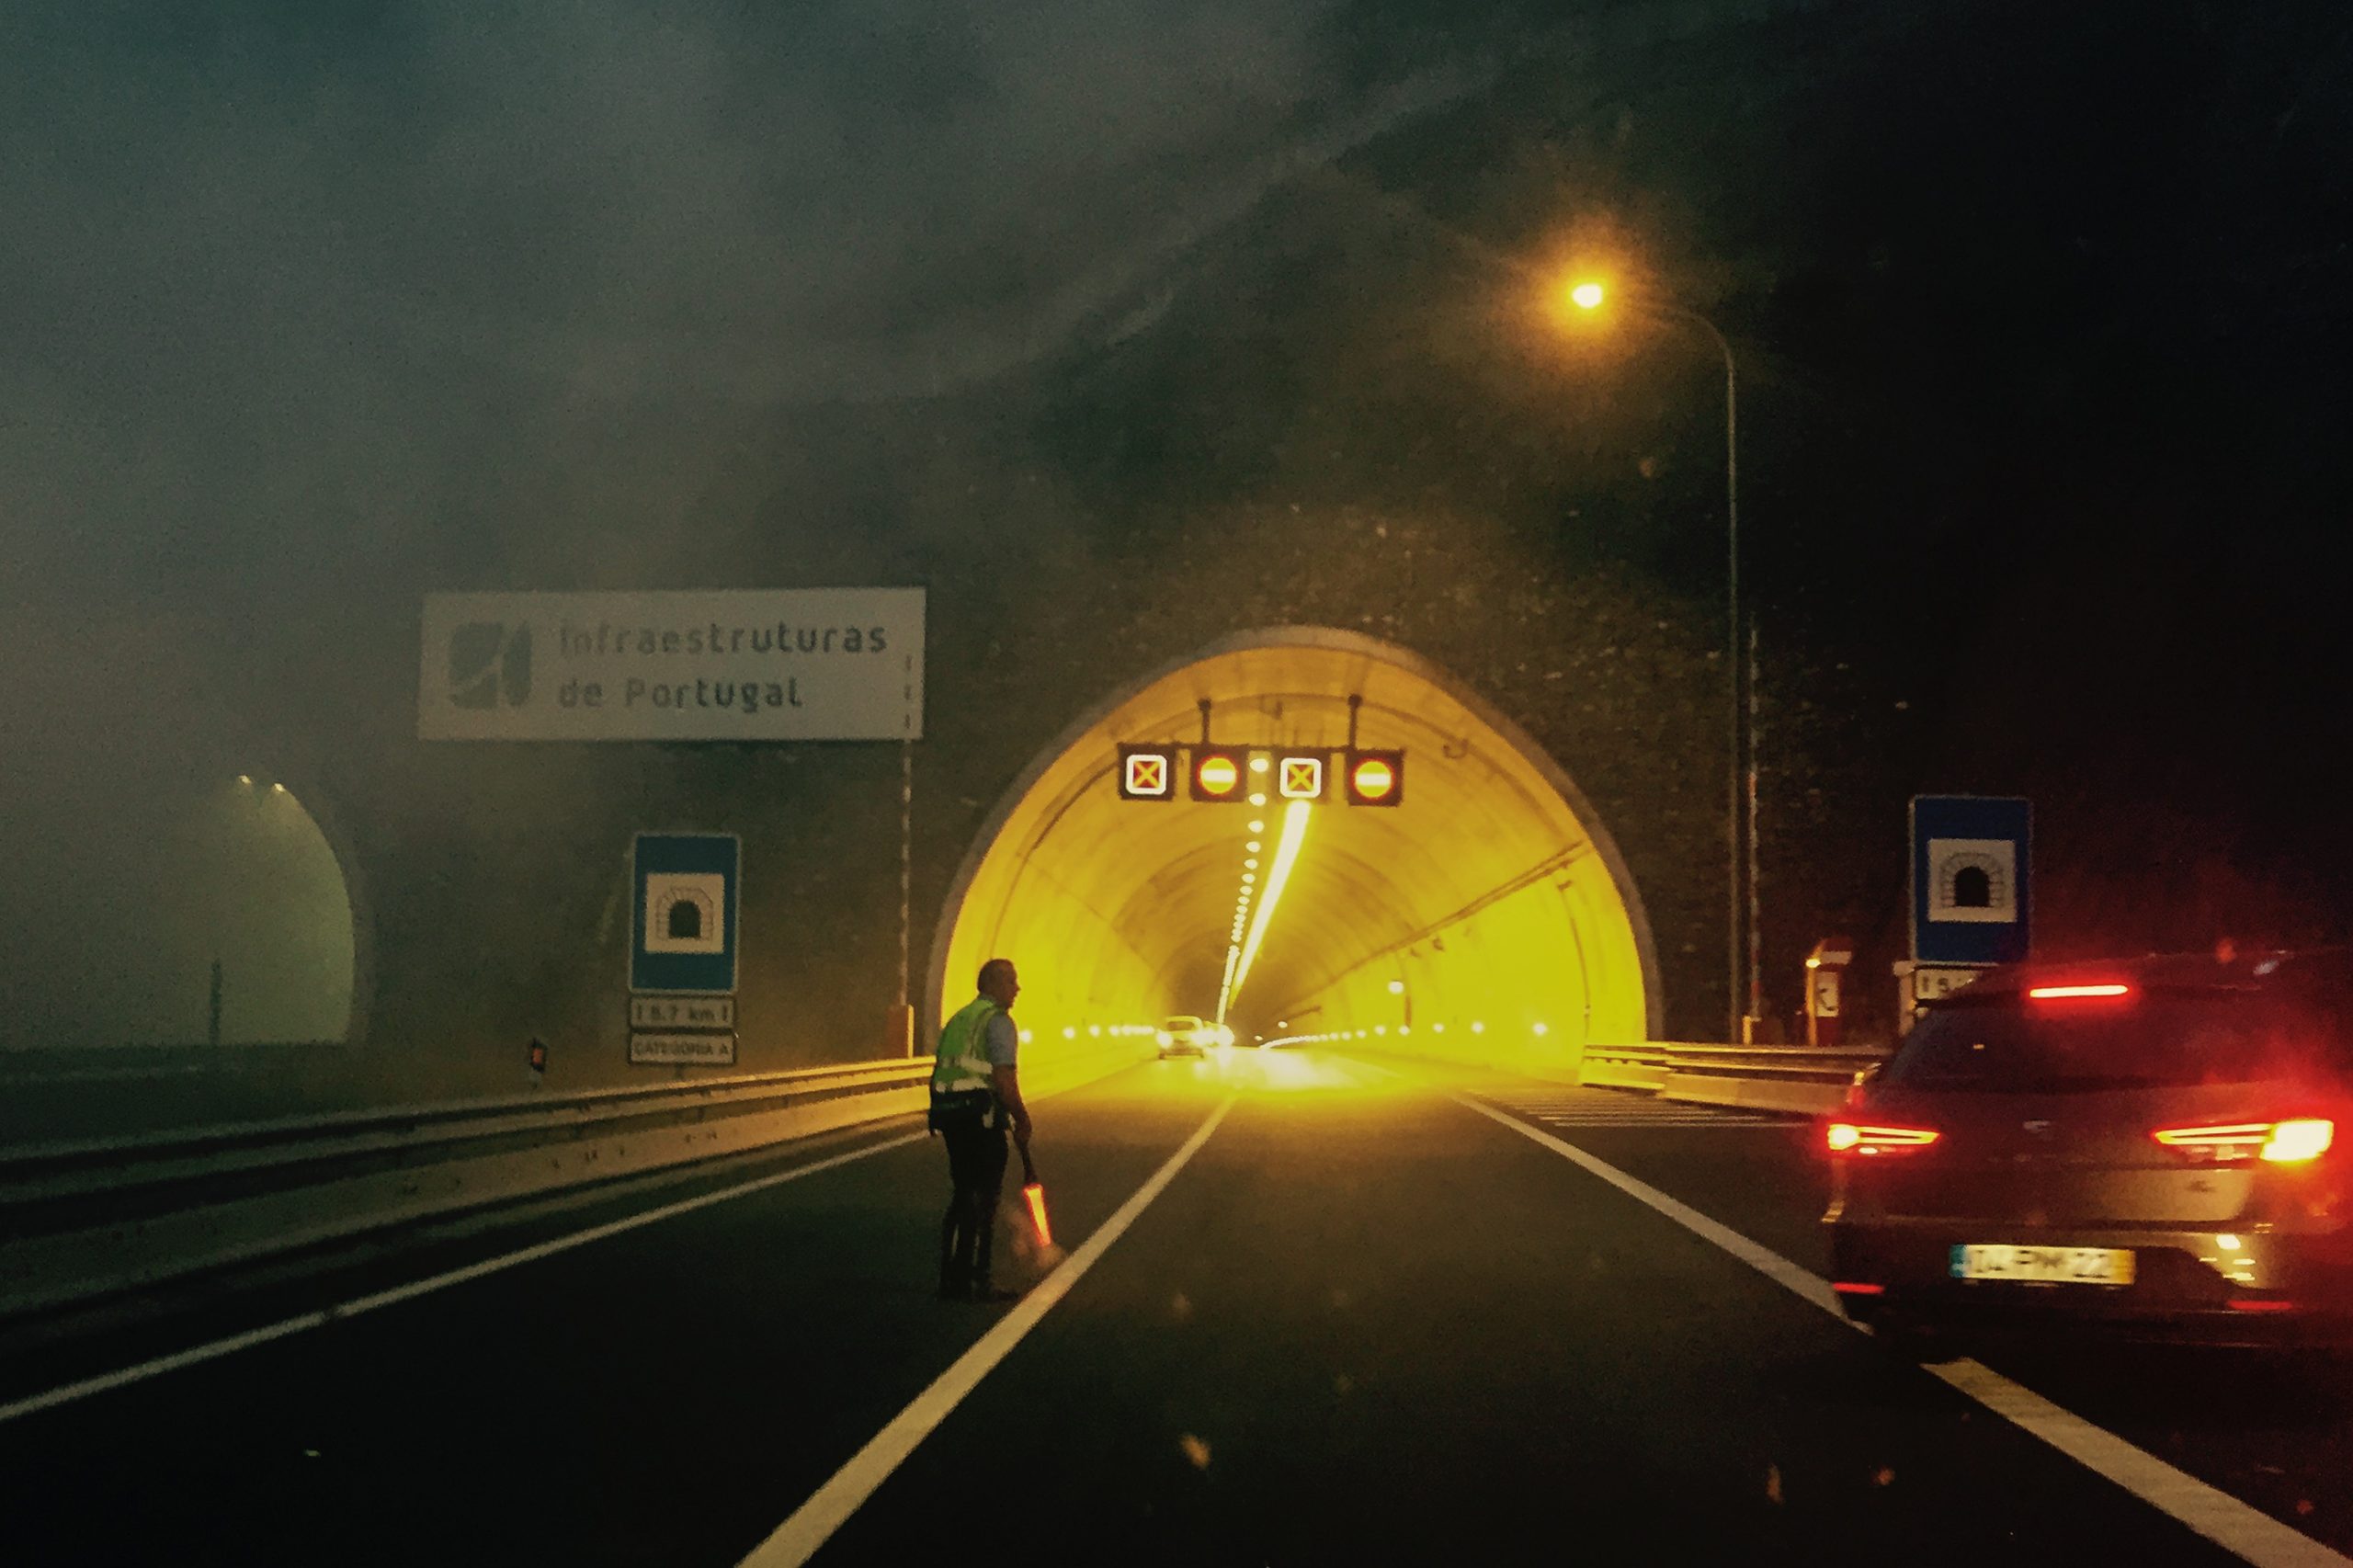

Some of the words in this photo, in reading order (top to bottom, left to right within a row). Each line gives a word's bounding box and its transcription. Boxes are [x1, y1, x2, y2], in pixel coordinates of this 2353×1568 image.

[559, 621, 888, 655] Infraestruturas
[559, 678, 603, 709] de
[625, 678, 803, 714] Portugal
